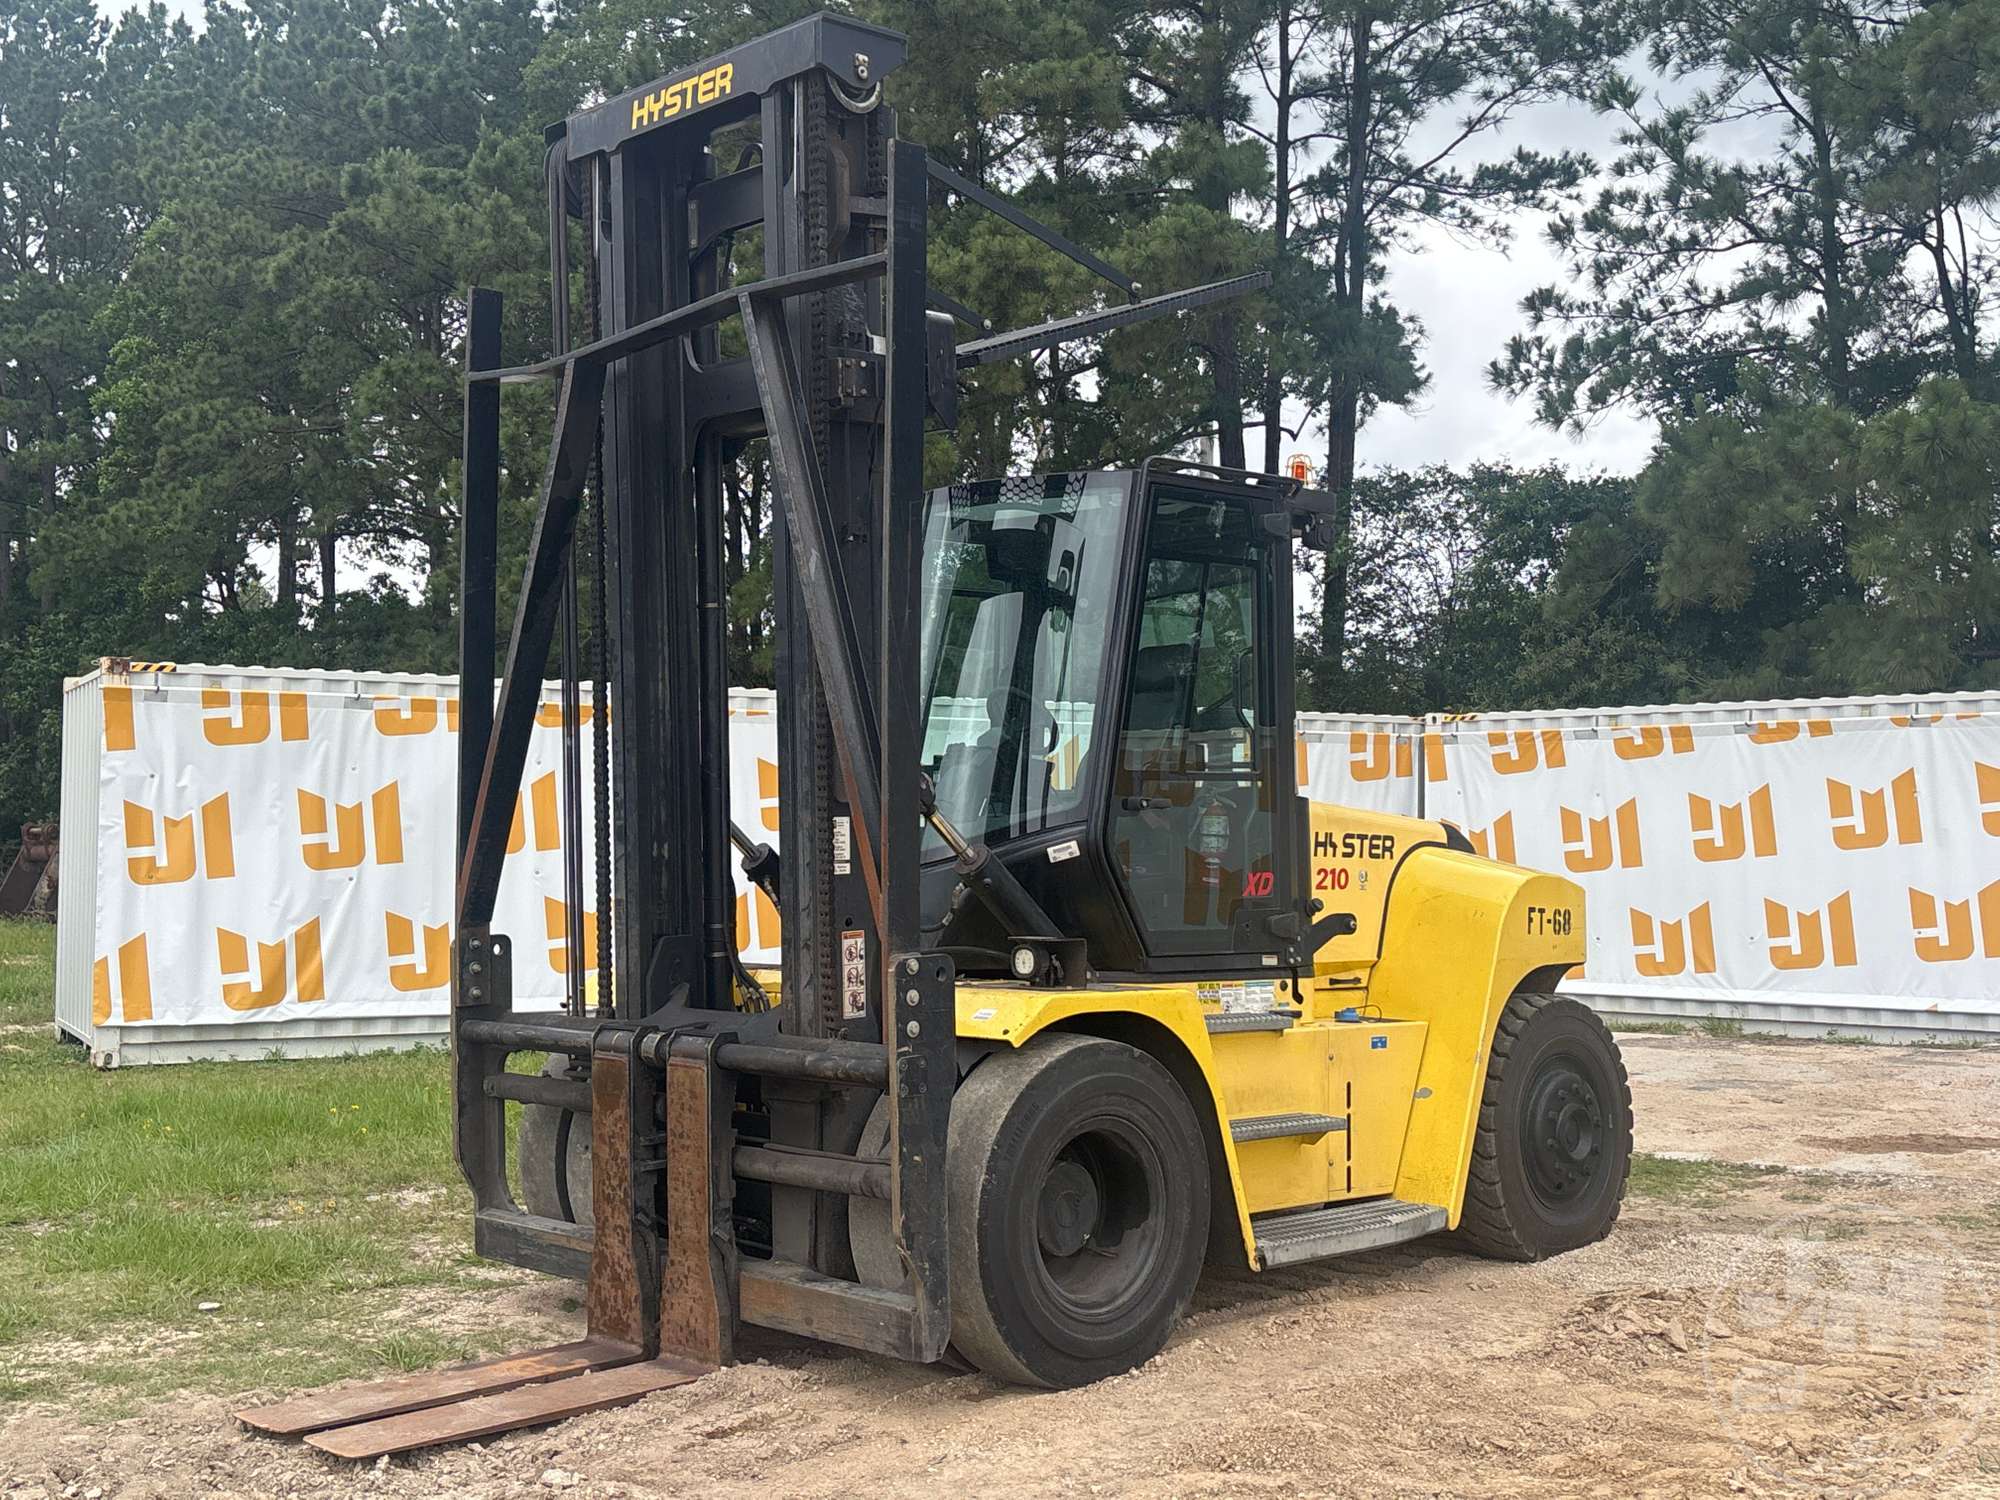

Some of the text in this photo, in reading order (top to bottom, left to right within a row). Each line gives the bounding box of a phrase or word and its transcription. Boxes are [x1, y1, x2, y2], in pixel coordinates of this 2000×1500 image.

[631, 62, 734, 131] HYSTER
[1242, 871, 1274, 897] XD
[1315, 867, 1349, 890] 210
[1527, 906, 1572, 936] FT-68
